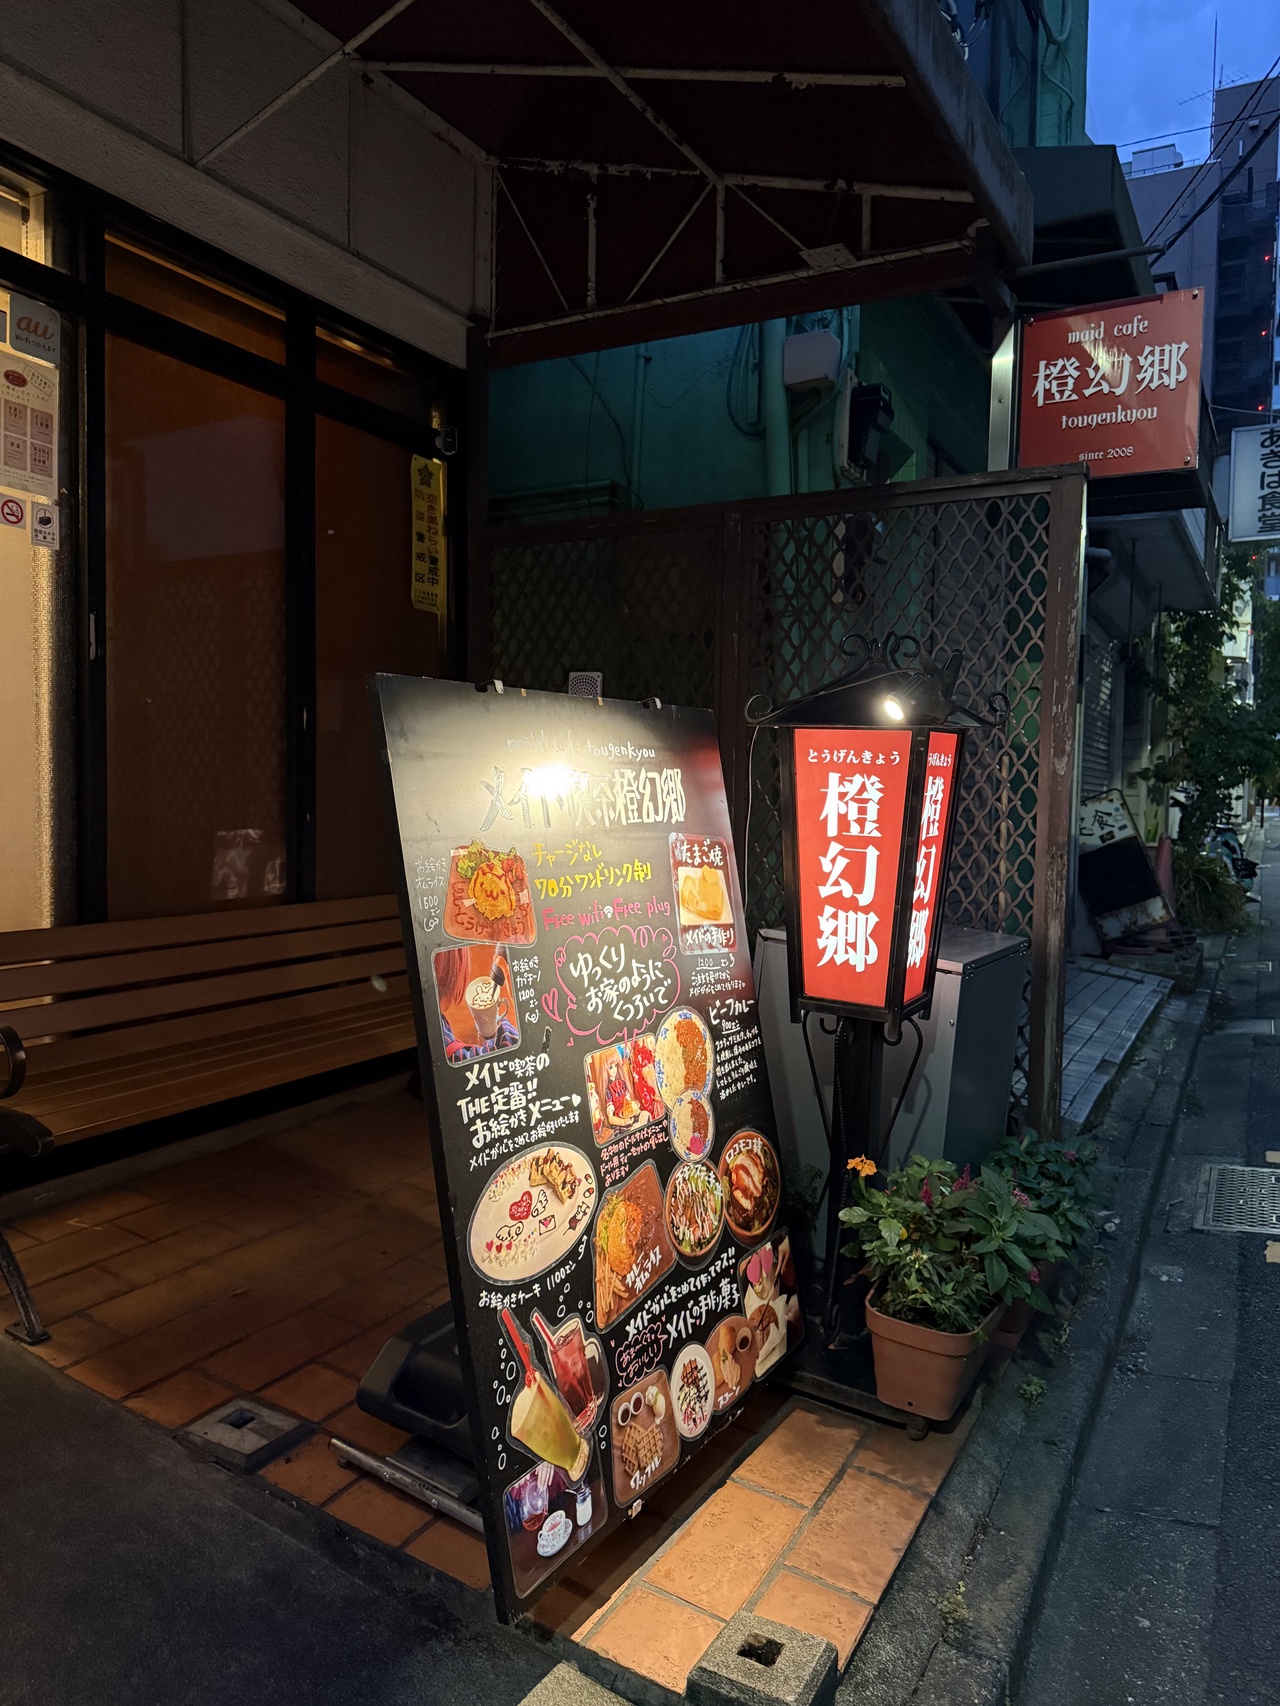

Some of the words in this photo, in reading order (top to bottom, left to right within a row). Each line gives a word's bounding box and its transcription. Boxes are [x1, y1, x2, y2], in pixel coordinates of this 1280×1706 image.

[16, 316, 55, 340] au
[1067, 321, 1105, 345] maid
[1113, 314, 1149, 339] cafe
[1031, 341, 1190, 408] 橙幻郷
[1060, 404, 1158, 431] tougenkyou
[1078, 450, 1104, 462] since
[1106, 446, 1134, 459] 2008
[586, 740, 656, 761] tougenkyou
[808, 749, 900, 765] とうげんきょう
[415, 856, 447, 873] お絵かき
[532, 839, 603, 868] チャージなし
[680, 838, 724, 867] たまご焼
[415, 876, 445, 889] オムライス
[534, 859, 652, 900] 70分ワンドリンク制
[816, 771, 885, 972] 橙幻郷
[906, 775, 945, 969] 橙幻郷
[542, 907, 575, 931] Free
[578, 900, 604, 927] wifi
[612, 898, 642, 921] Free
[646, 895, 670, 918] plug
[685, 927, 735, 946] メイドの手作り
[512, 955, 539, 972] お絵かき
[569, 943, 625, 988] ゆっくり
[698, 957, 713, 967] 1200
[585, 959, 664, 1014] お家のように
[613, 979, 671, 1021] くつろいで
[709, 998, 755, 1025] ビーフカレー
[465, 1053, 550, 1091] メイド喫茶の
[469, 1095, 571, 1149] お絵かきメニュー
[725, 1137, 764, 1164] ロコモコ丼
[478, 1283, 542, 1310] お絵かきケーキ
[665, 1277, 741, 1350] メイドの手作り菓子
[717, 1385, 741, 1409] スコーン
[629, 1457, 662, 1490] ワッフル
